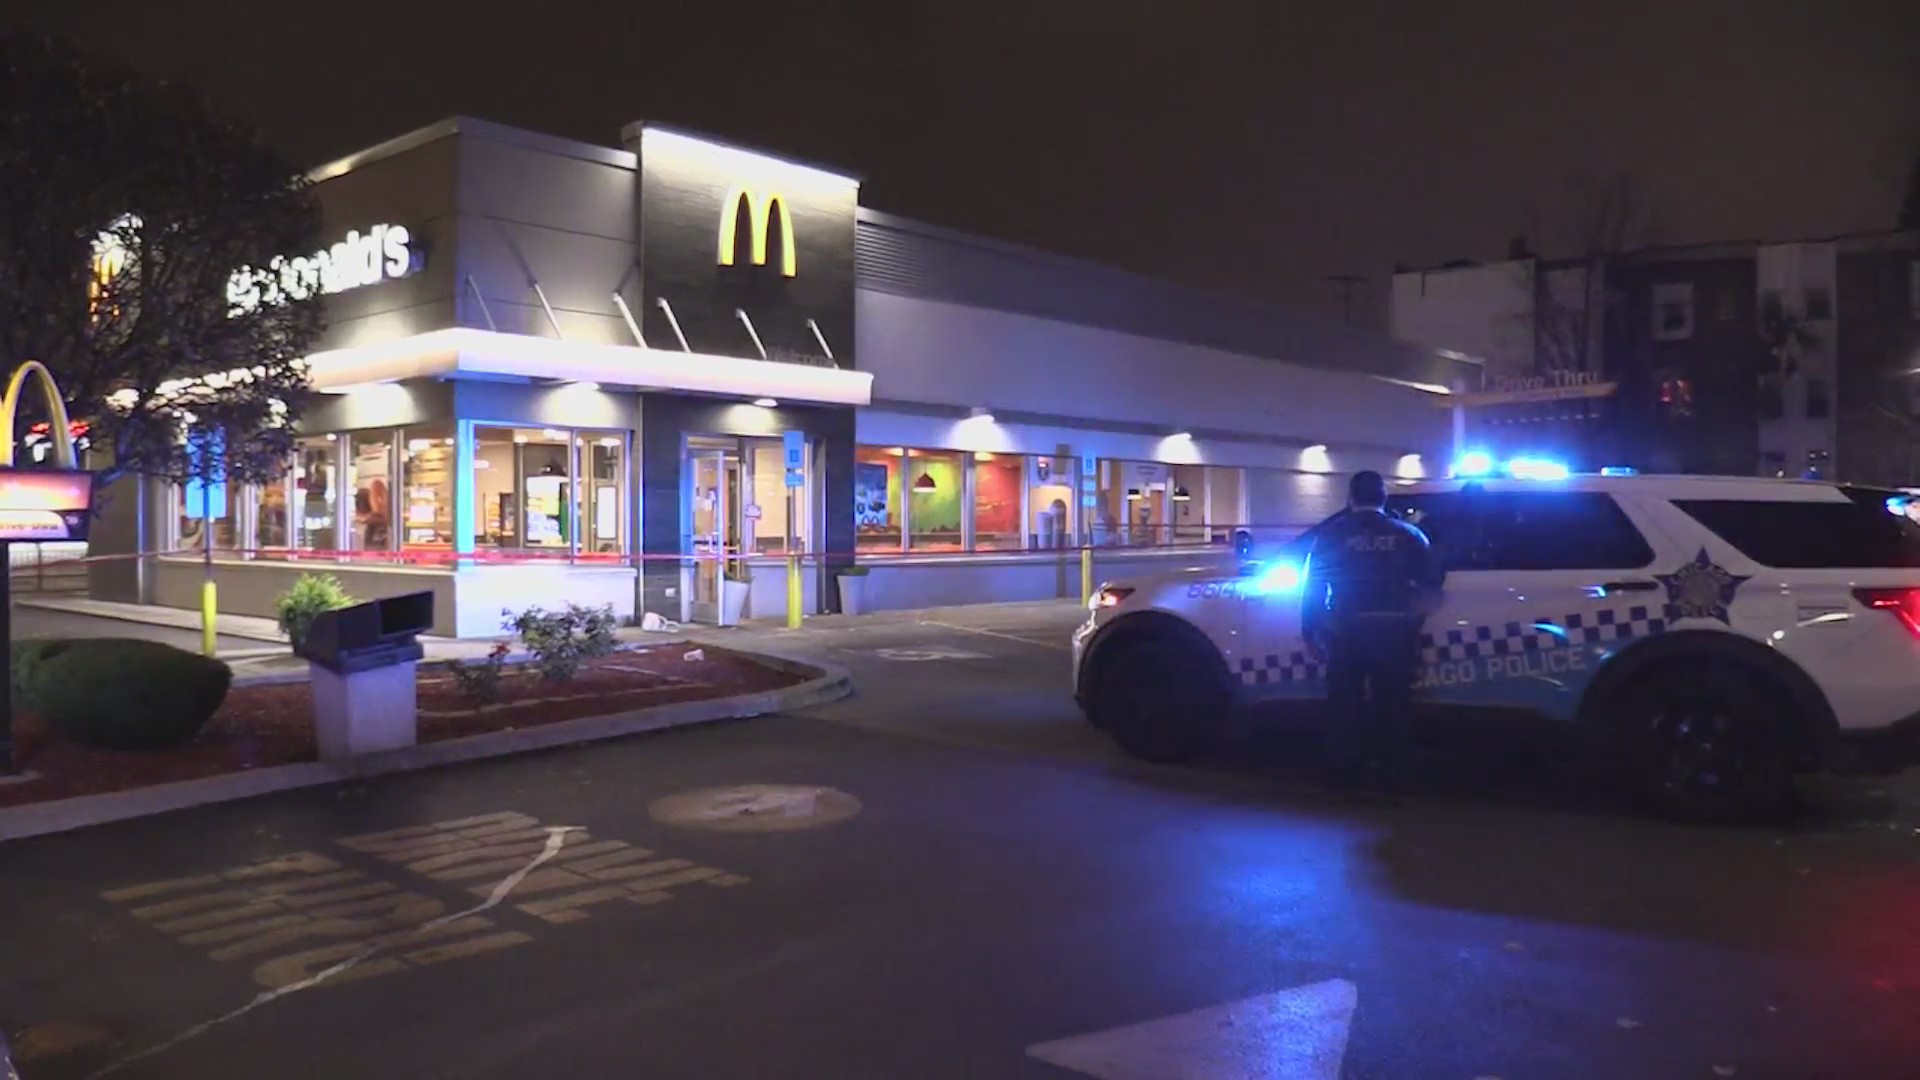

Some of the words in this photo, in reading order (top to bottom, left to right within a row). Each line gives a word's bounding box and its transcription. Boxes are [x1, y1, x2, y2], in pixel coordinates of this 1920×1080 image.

[1495, 374, 1546, 393] Drive
[1554, 368, 1599, 387] Thru
[1346, 534, 1399, 552] POLICE
[1486, 648, 1588, 681] POLICE
